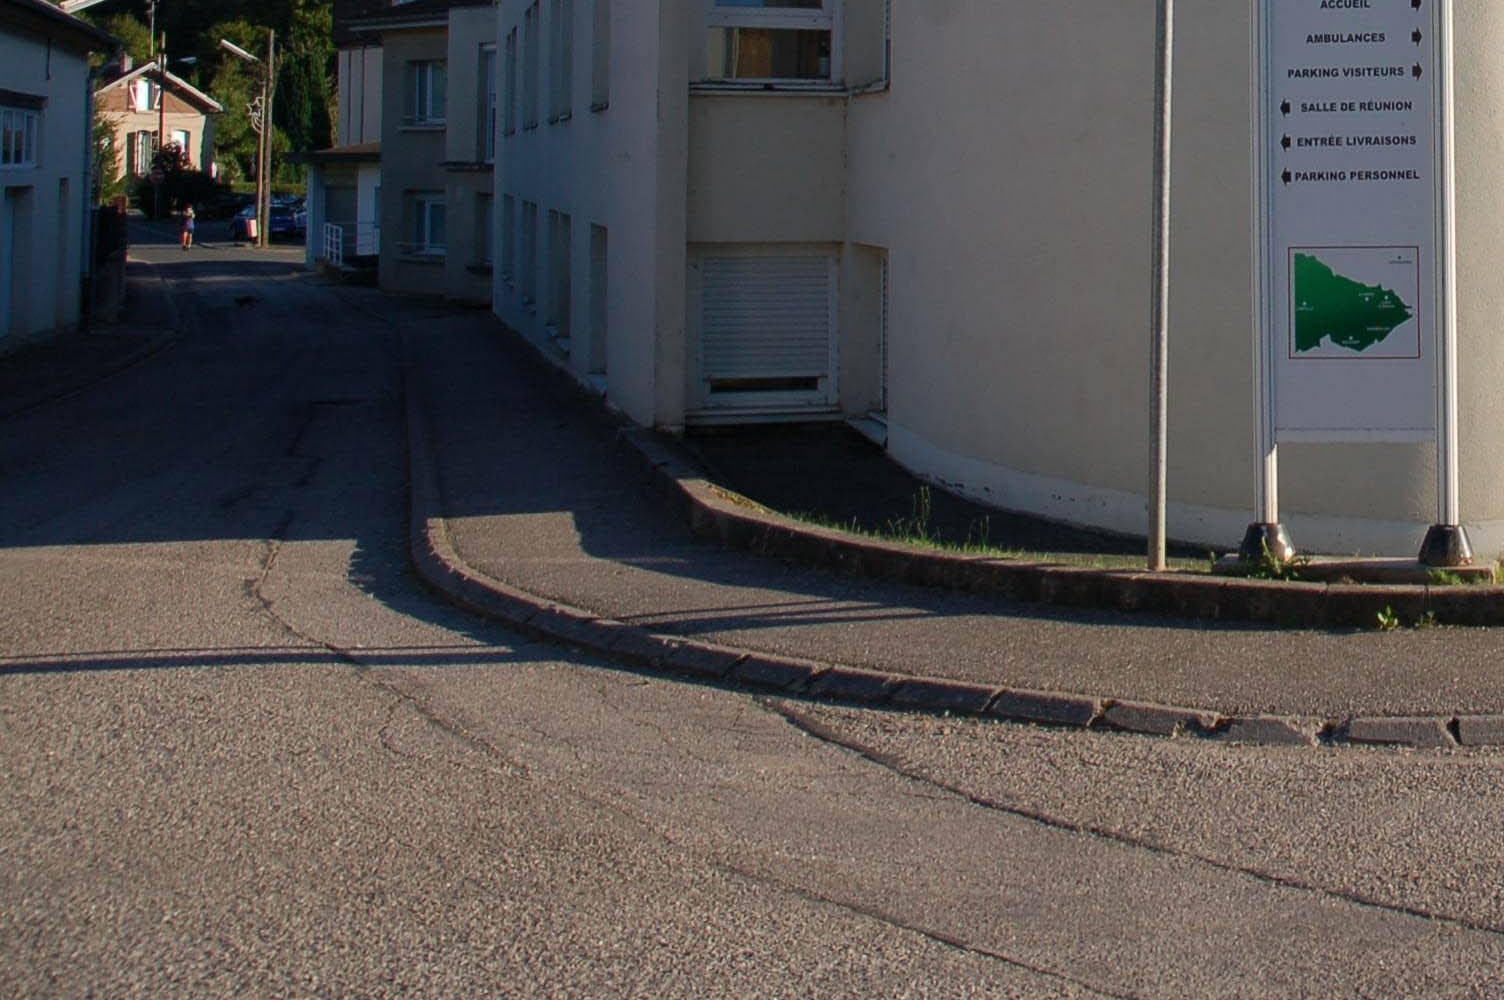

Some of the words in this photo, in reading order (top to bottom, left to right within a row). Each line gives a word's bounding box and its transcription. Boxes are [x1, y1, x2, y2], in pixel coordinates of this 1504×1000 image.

[1320, 0, 1371, 9] ACCUEIL
[1306, 33, 1386, 44] AMBULANCES
[1287, 68, 1339, 79] PARKING
[1343, 67, 1405, 78] VISITEURS
[1301, 102, 1337, 113] SALLE
[1340, 102, 1356, 112] DE
[1359, 99, 1413, 111] RÉUNION
[1297, 134, 1343, 147] ENTRÉE
[1346, 135, 1417, 146] LIVRAISONS
[1295, 171, 1346, 182] PARKING
[1350, 170, 1421, 181] PERSONNEL
